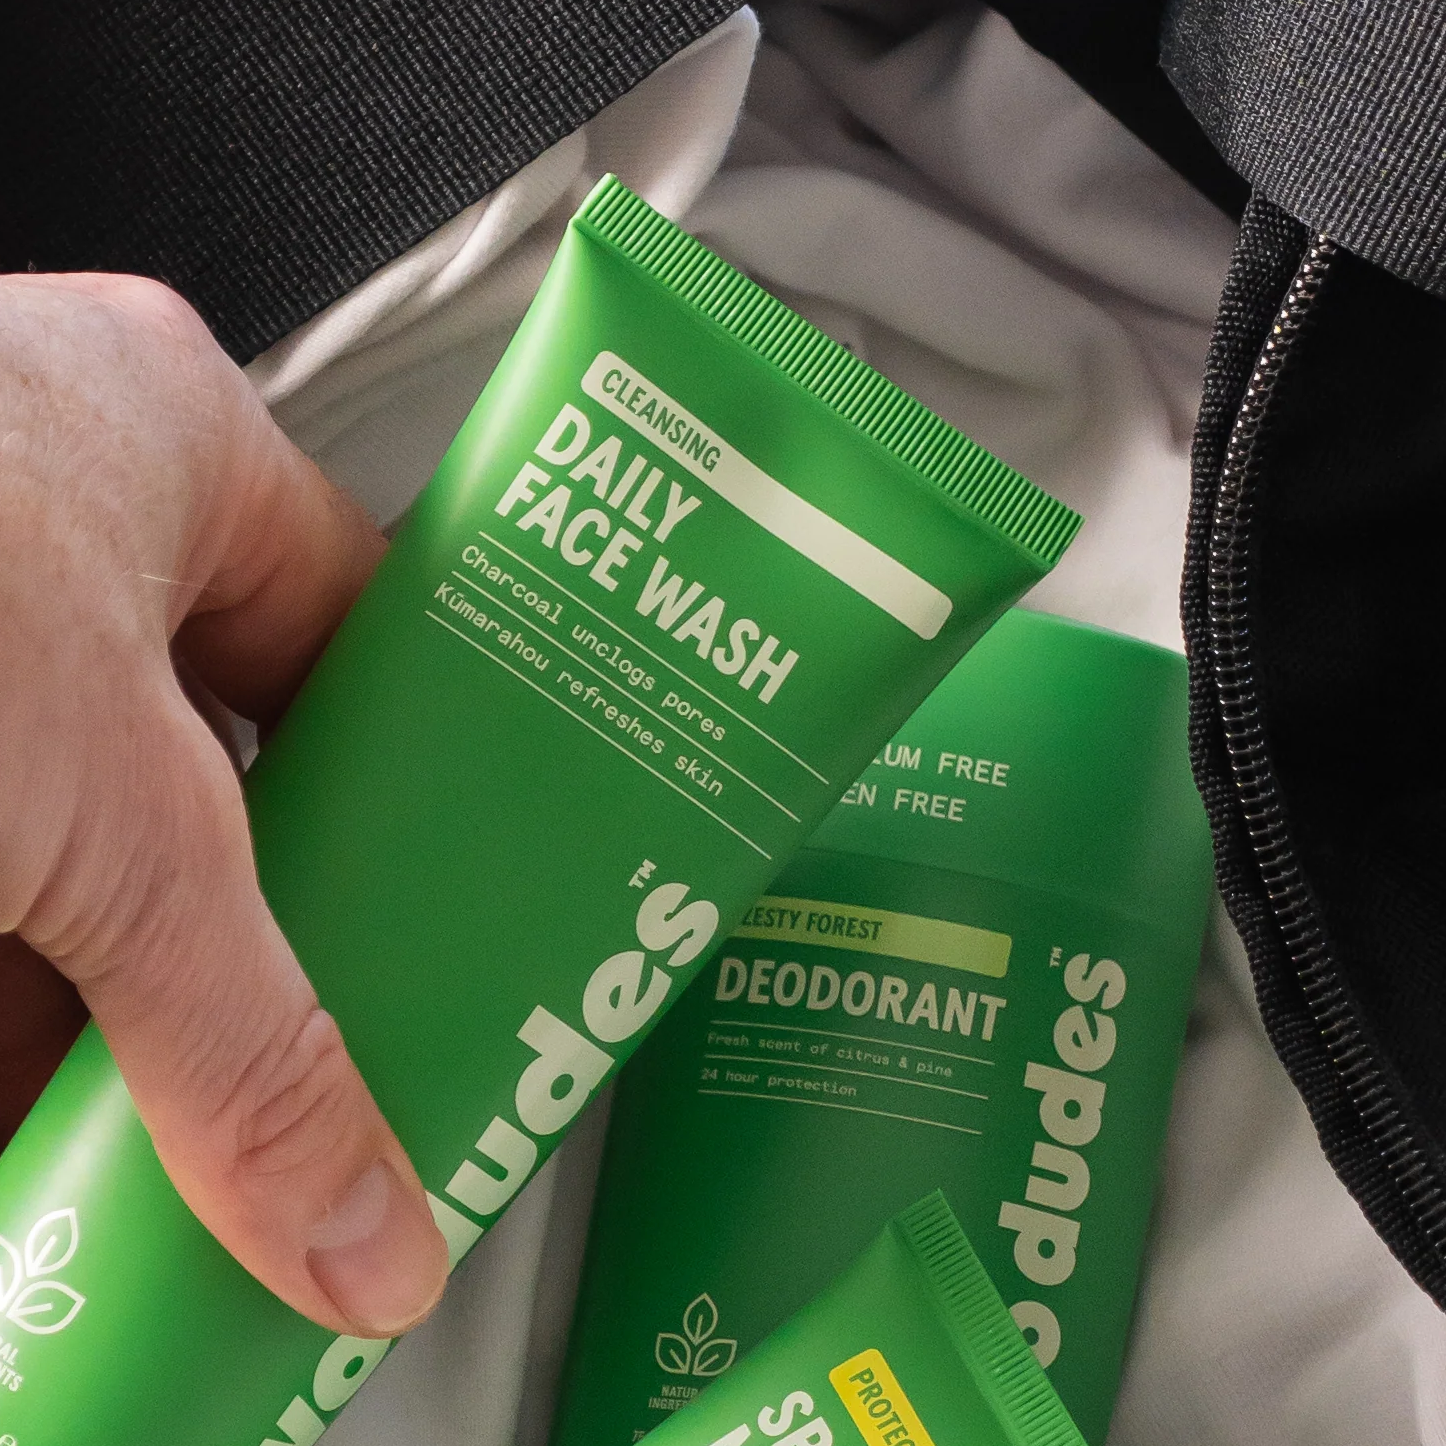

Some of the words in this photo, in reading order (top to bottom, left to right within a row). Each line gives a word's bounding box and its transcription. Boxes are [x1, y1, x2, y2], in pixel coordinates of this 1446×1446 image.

[602, 369, 721, 473] CLEANSING
[534, 402, 702, 544] DAILY
[494, 461, 643, 592] FACE
[635, 555, 799, 705] WASH
[461, 545, 564, 625] Charcoal
[570, 623, 656, 691] unclogs
[661, 691, 726, 742] pores
[556, 670, 665, 754] refreshes
[674, 755, 724, 797] skin
[937, 752, 1011, 787] FREE
[893, 788, 967, 822] FREE
[807, 912, 883, 941] FOREST
[715, 957, 1007, 1041] DEODORANT
[701, 1067, 718, 1081] 24
[725, 1068, 759, 1084] hour
[767, 1074, 857, 1098] protection
[707, 1031, 750, 1048] Fresh
[758, 1038, 801, 1053] scent
[810, 1043, 829, 1056] of
[836, 1046, 890, 1066] citrus
[898, 1057, 907, 1069] &
[915, 1059, 953, 1079] pine
[998, 953, 1126, 1287] dudes
